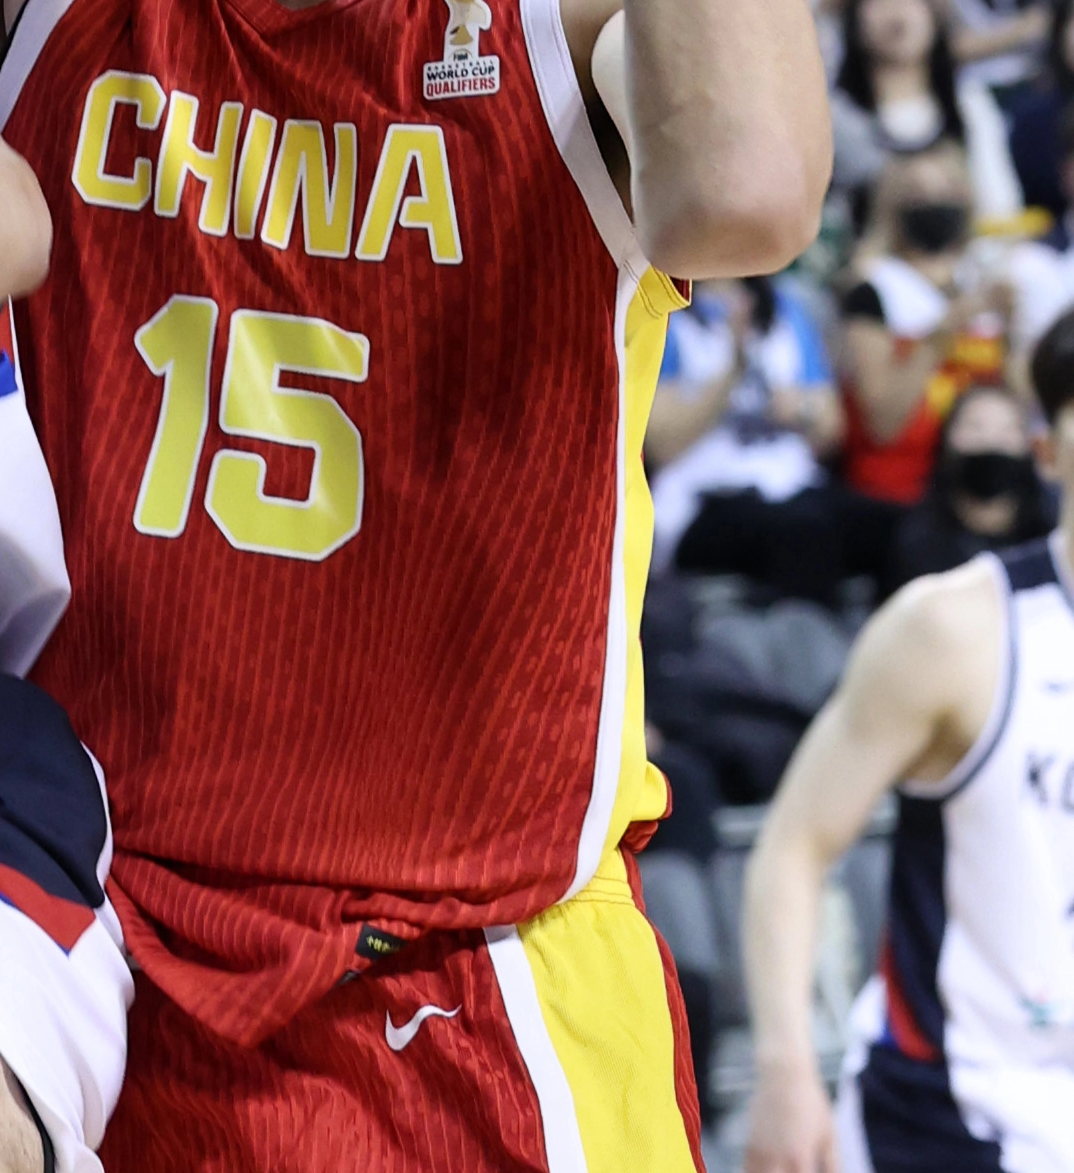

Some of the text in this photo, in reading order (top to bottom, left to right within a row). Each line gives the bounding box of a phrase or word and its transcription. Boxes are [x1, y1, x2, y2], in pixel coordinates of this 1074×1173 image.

[426, 76, 496, 97] QUALIFIERS
[427, 65, 495, 82] WORLD CUP
[72, 69, 464, 265] CHINA
[133, 293, 370, 562] 15
